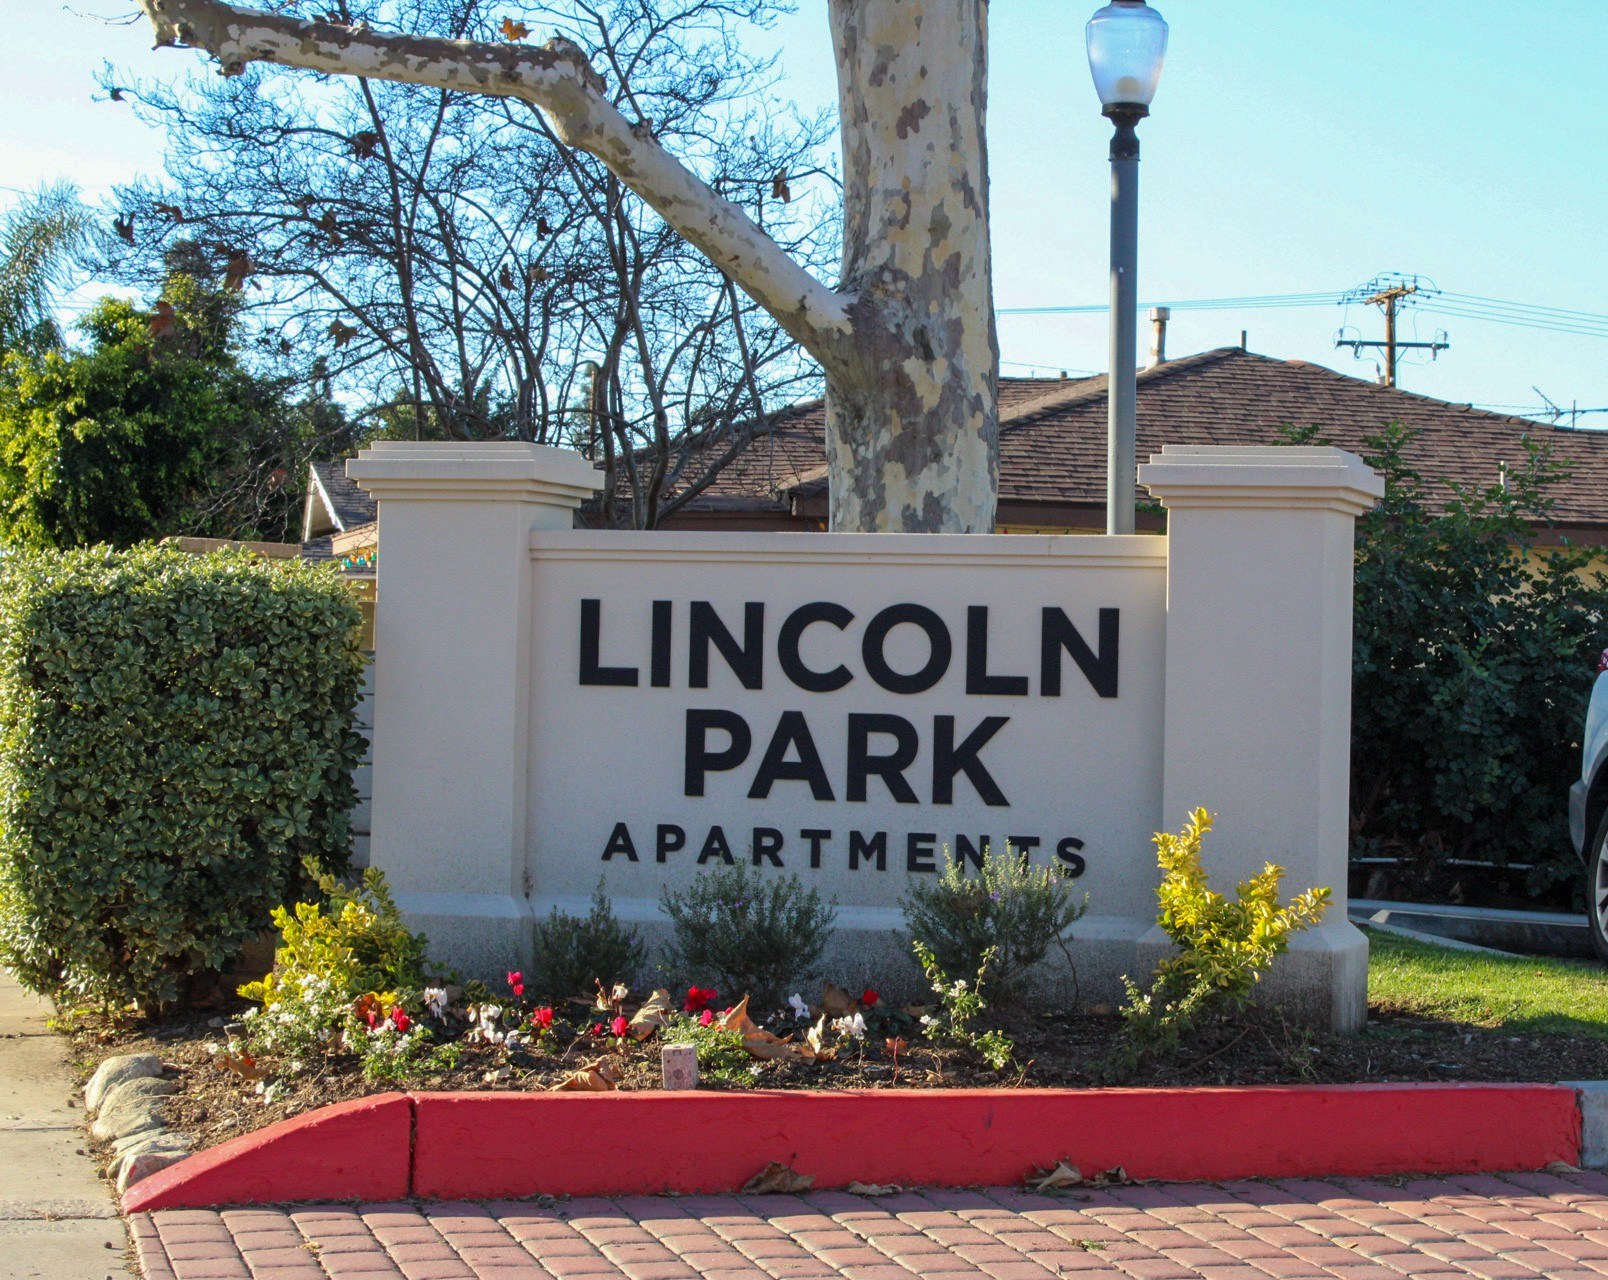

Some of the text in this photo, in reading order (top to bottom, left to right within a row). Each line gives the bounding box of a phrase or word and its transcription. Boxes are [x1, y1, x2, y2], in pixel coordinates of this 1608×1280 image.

[579, 598, 1120, 698] LINCOLN
[685, 708, 1011, 807] PARK
[601, 821, 1086, 880] APARTMENTS
